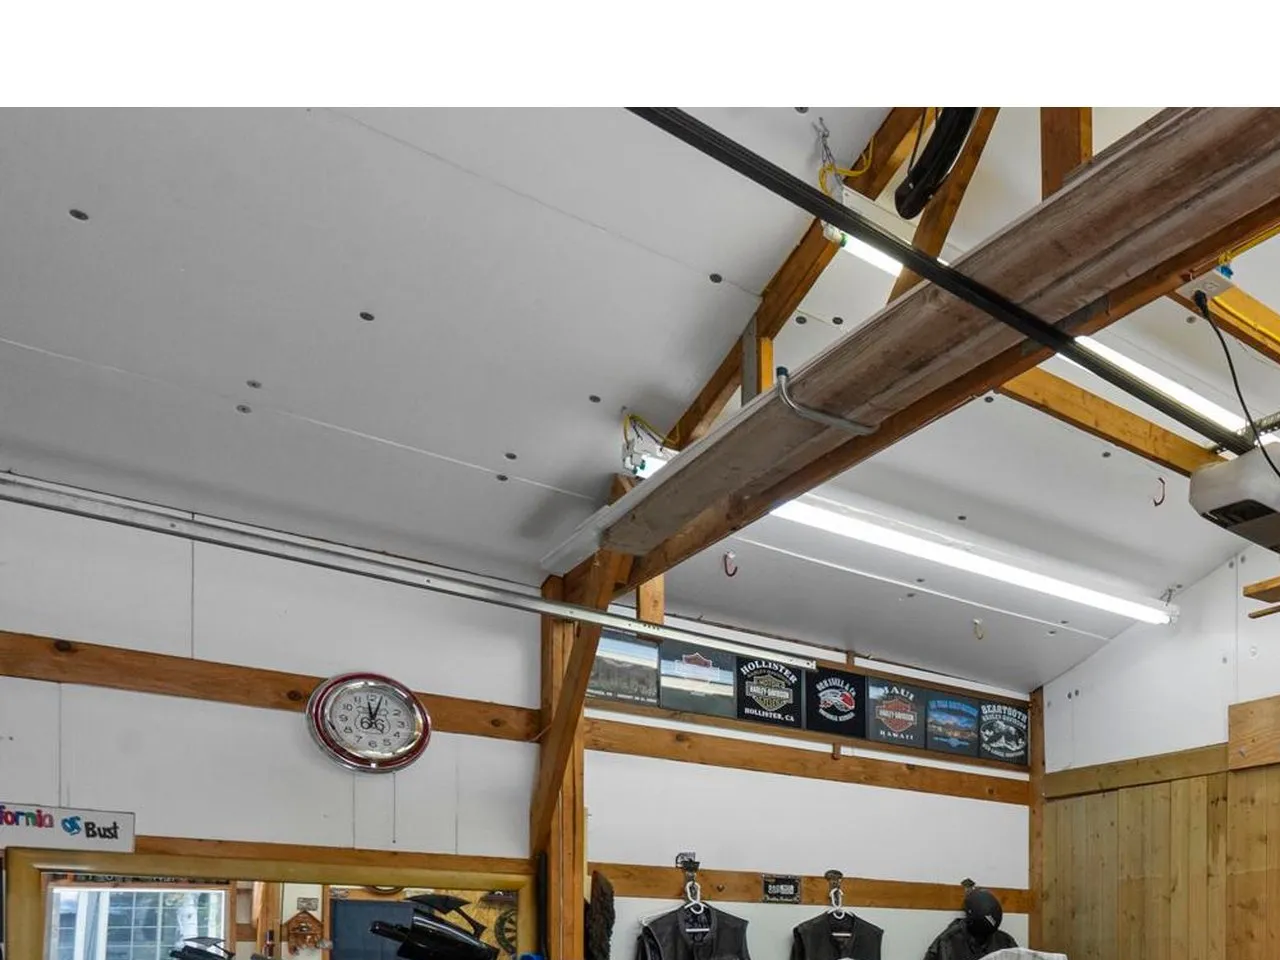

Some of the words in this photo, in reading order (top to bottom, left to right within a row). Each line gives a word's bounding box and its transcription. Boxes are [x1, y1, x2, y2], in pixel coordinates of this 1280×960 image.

[740, 660, 799, 684] HOLLISTER
[784, 714, 795, 722] CA
[981, 704, 1028, 723] BEARTOOTH
[84, 821, 120, 839] Bust
